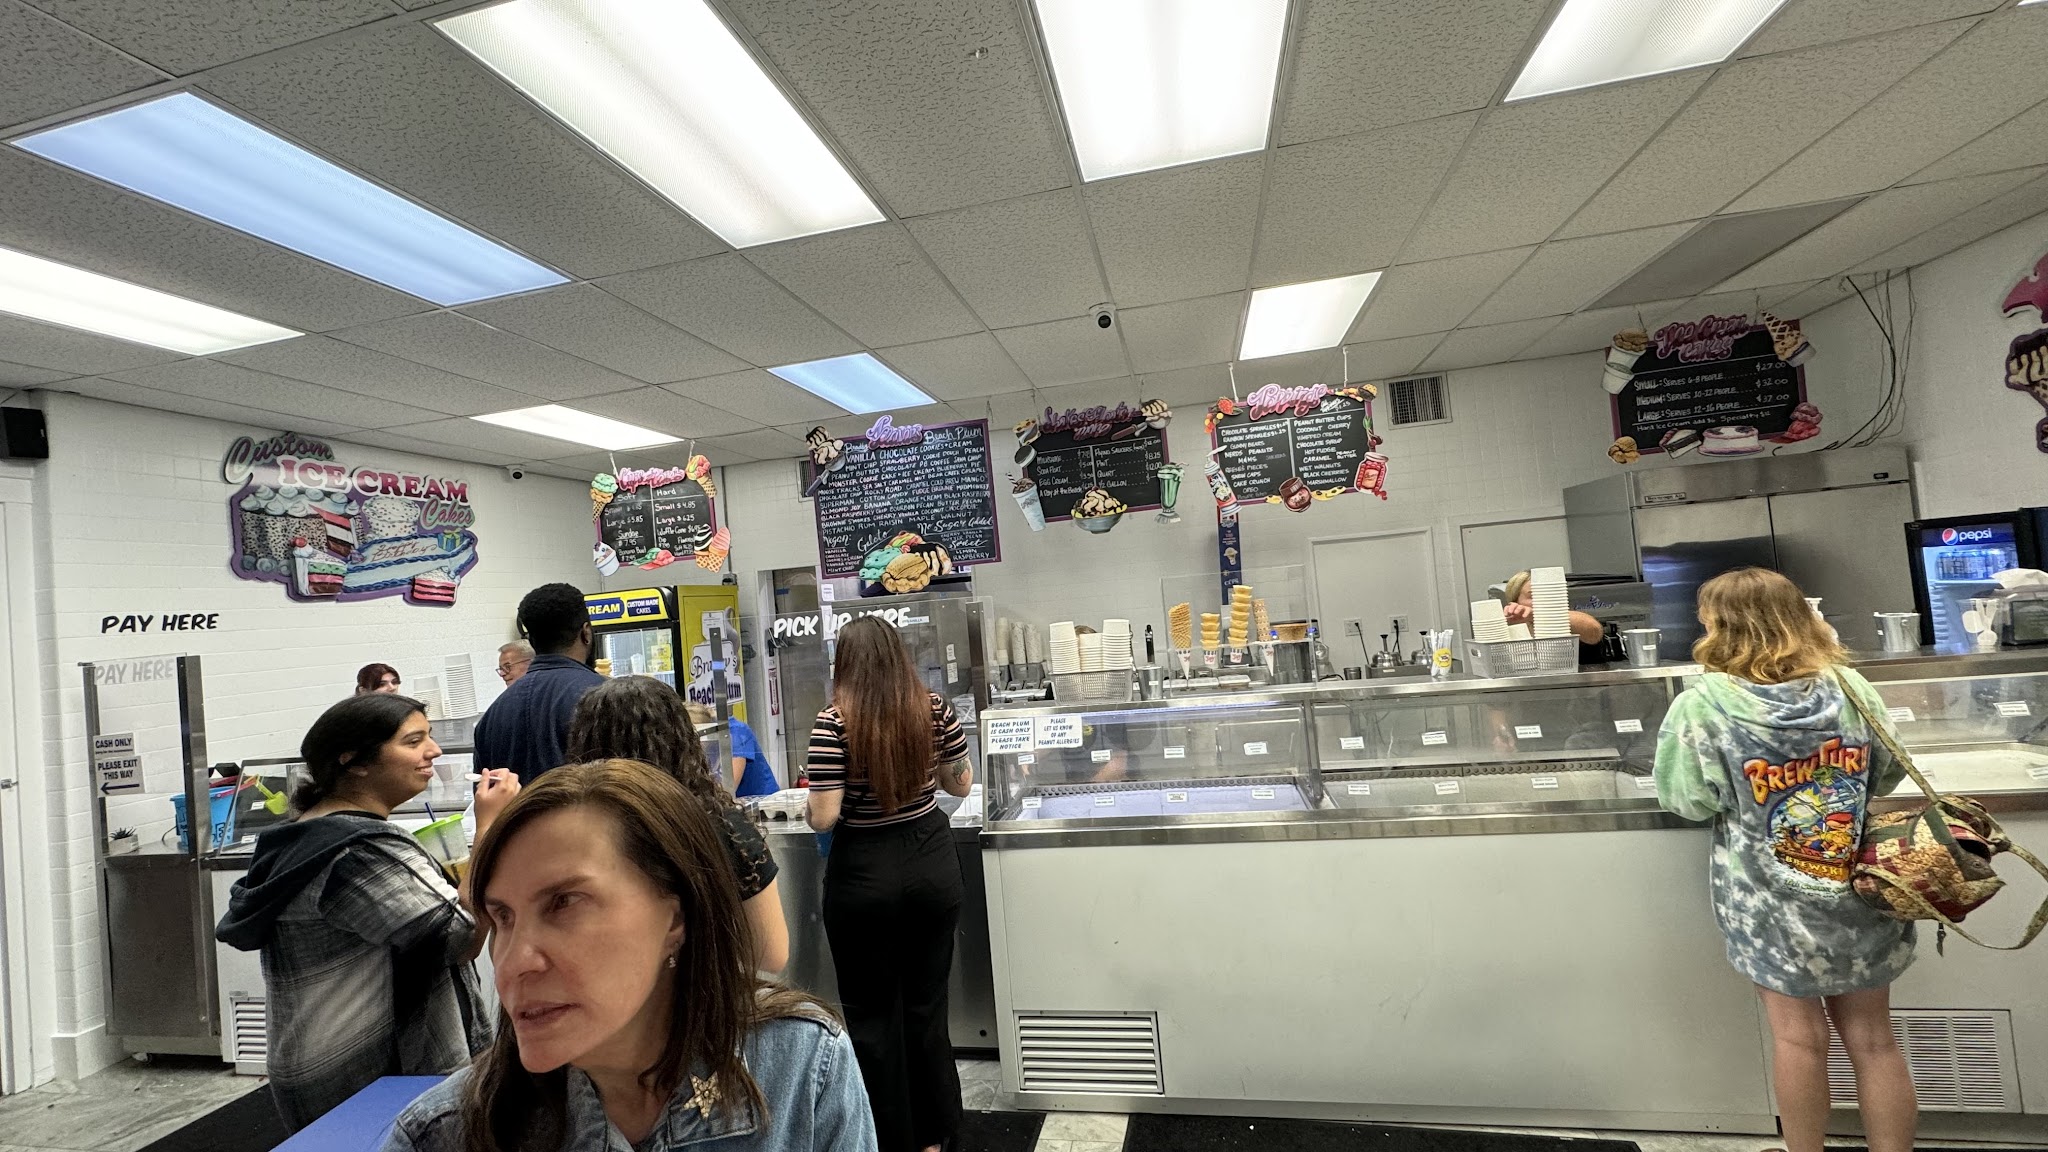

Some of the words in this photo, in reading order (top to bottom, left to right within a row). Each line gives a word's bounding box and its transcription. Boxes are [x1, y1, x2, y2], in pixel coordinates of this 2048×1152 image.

[923, 429, 954, 444] Beach
[955, 427, 982, 439] Plum
[1221, 428, 1248, 436] CHOCOLATE
[1296, 440, 1324, 448] CHOCOLATE
[224, 431, 334, 484] Custom
[846, 452, 876, 463] VANILLA
[880, 446, 918, 460] CHOCOLATE
[1225, 450, 1243, 458] NERDS
[1249, 447, 1273, 455] PEANUTS
[846, 464, 860, 472] MINT
[880, 455, 920, 466] STRAWBERRY
[923, 452, 940, 460] COOKIE
[1303, 455, 1332, 463] CARAMEL
[832, 472, 853, 480] PEANUT
[882, 463, 915, 473] CHOCOLATE
[930, 458, 950, 466] COFFEE
[1097, 470, 1116, 478] QUART
[279, 459, 347, 490] ICE
[355, 469, 469, 503] CREAM
[829, 479, 858, 487] MONSTER
[860, 475, 878, 483] COOKIE
[888, 478, 912, 486] CARAMEL
[1039, 478, 1050, 486] EGG
[1307, 477, 1347, 485] MARSHMALLOW
[657, 488, 676, 496] Hard
[819, 493, 848, 501] CHOCOLATE
[906, 481, 929, 490] CARAMEL
[820, 499, 854, 509] SUPERMAN
[887, 491, 908, 499] CANDY
[912, 486, 930, 495] FUDGE
[655, 503, 675, 511] Small
[821, 507, 848, 515] ALMOND
[864, 501, 891, 510] BANANA
[422, 498, 474, 530] Cakes
[842, 510, 874, 518] RASPBERRY
[607, 520, 625, 528] Large
[656, 517, 676, 525] Large
[823, 526, 855, 534] PISTACHIO
[909, 514, 935, 522] MAPLE
[934, 520, 966, 532] Sugar
[618, 529, 639, 537] Sundae
[1958, 527, 1993, 542] pepsi
[858, 528, 892, 551] Gelato
[586, 604, 620, 615] REAM
[101, 614, 154, 633] PAY
[162, 613, 219, 631] HERE
[773, 615, 818, 639] PICK
[95, 663, 127, 684] PAY
[133, 658, 175, 681] HERE
[96, 740, 113, 748] CASH
[115, 738, 132, 747] ONLY
[98, 761, 121, 770] PLEASE
[123, 759, 137, 767] EXIT
[104, 771, 118, 780] THIS
[120, 770, 133, 778] WAY
[1785, 856, 1843, 876] BREWSKI
